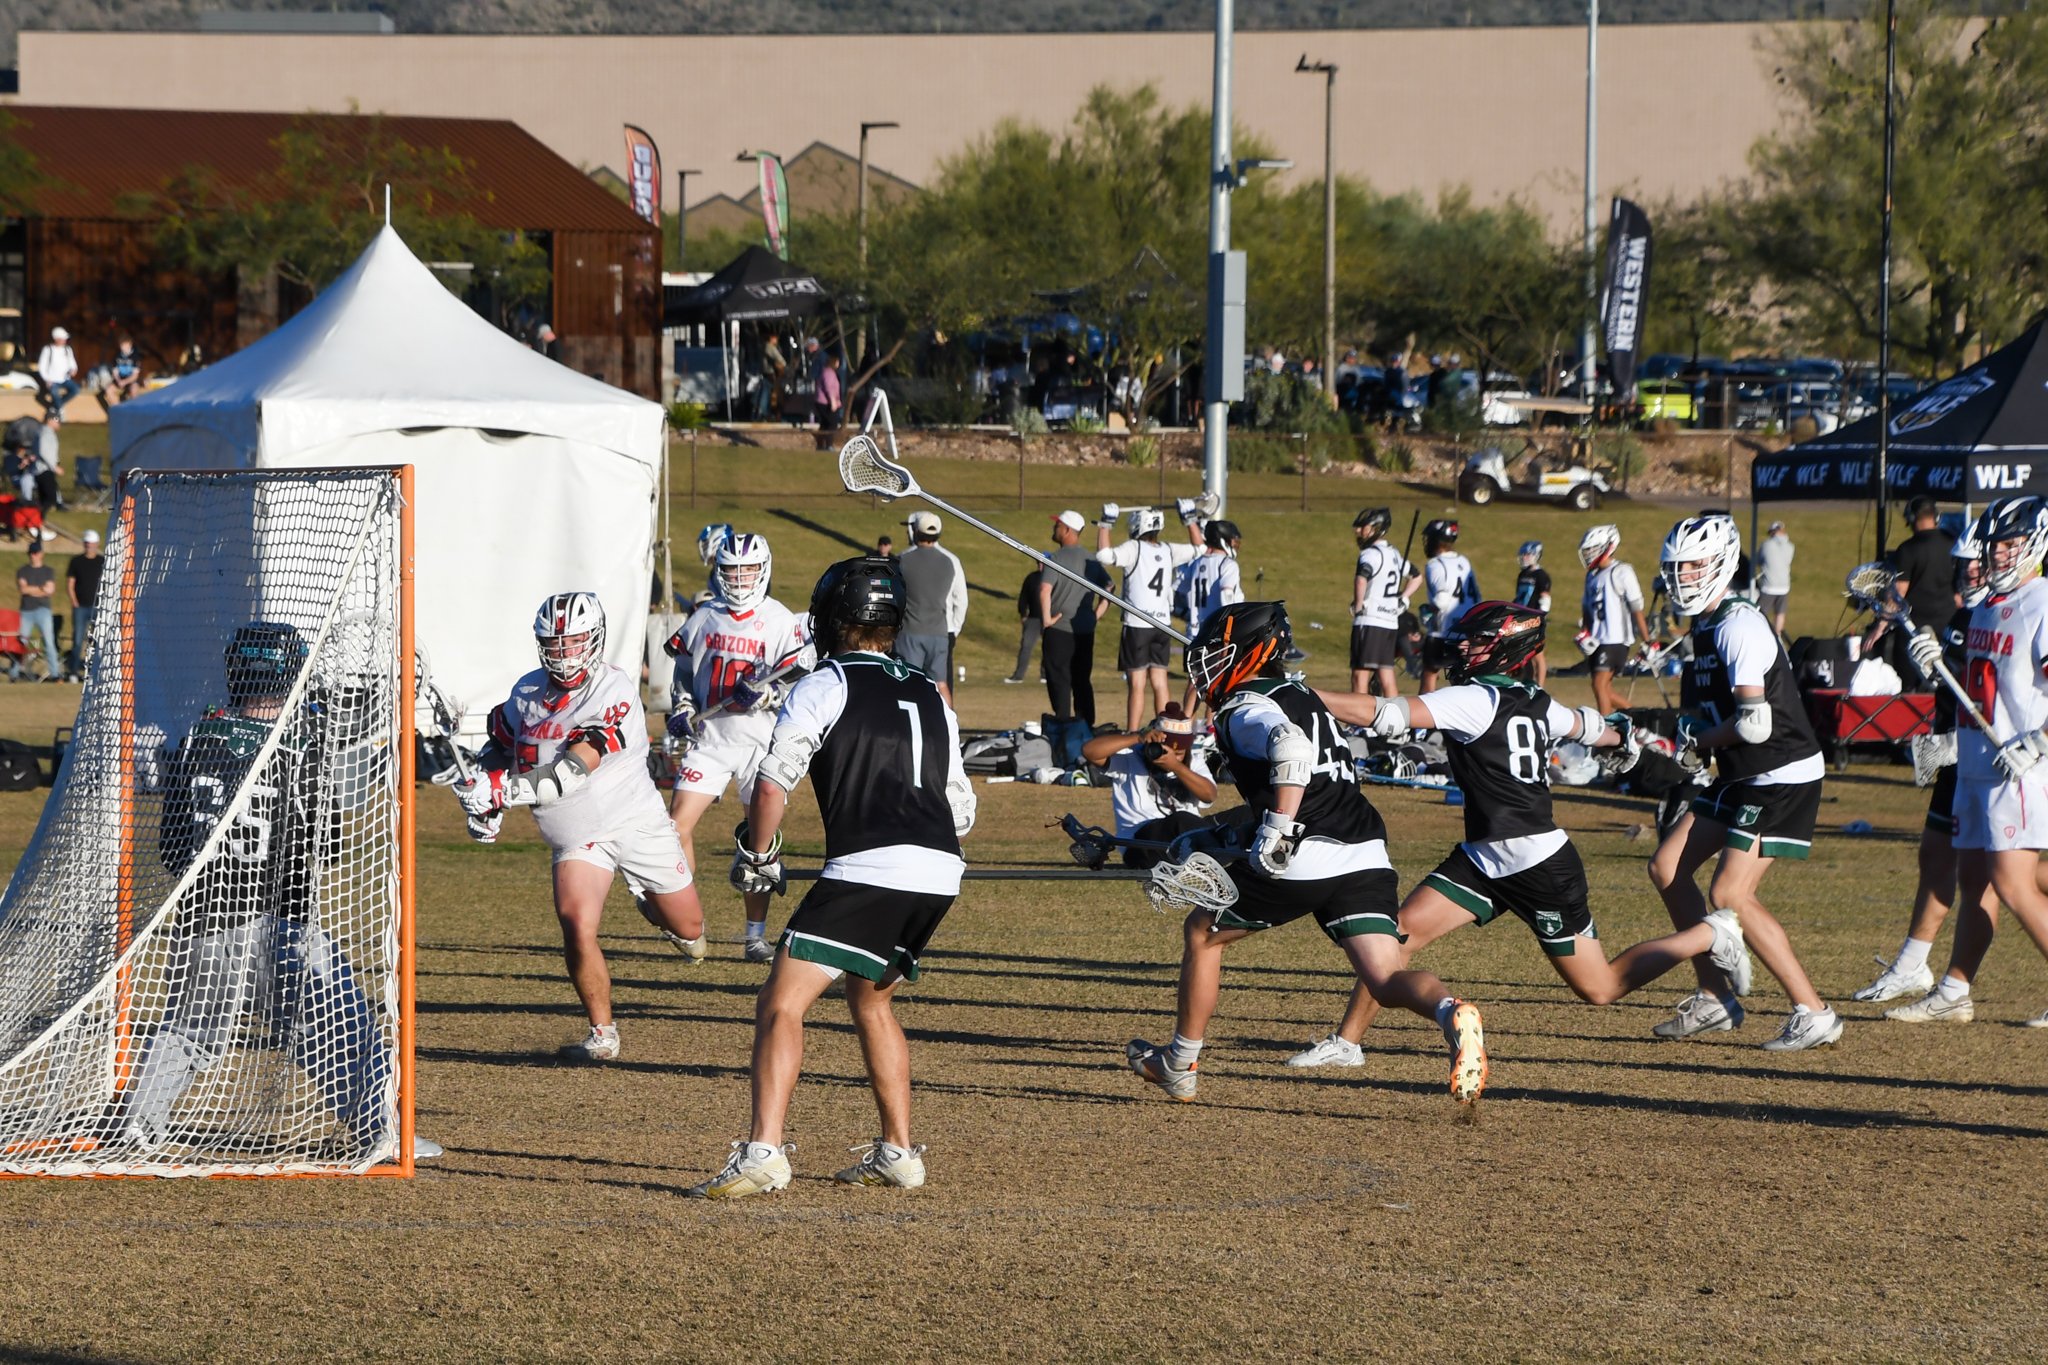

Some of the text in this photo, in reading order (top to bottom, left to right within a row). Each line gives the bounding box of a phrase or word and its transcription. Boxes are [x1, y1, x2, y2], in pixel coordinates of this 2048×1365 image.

[1614, 236, 1647, 352] WESTERN
[1756, 465, 1790, 488] WLF
[1796, 462, 1829, 486] WLF
[1840, 461, 1873, 485] WLF
[1885, 465, 1920, 487] WLF
[1927, 466, 1963, 489] WLF
[1975, 463, 2032, 490] WLF
[1148, 567, 1164, 597] 4
[1194, 578, 1208, 608] 11
[1383, 570, 1401, 598] 2
[1452, 576, 1478, 604] 44
[705, 633, 765, 658] ARIZONA
[707, 656, 755, 713] 10
[897, 700, 923, 789] 1
[785, 748, 808, 771] STX
[680, 766, 704, 783] 48
